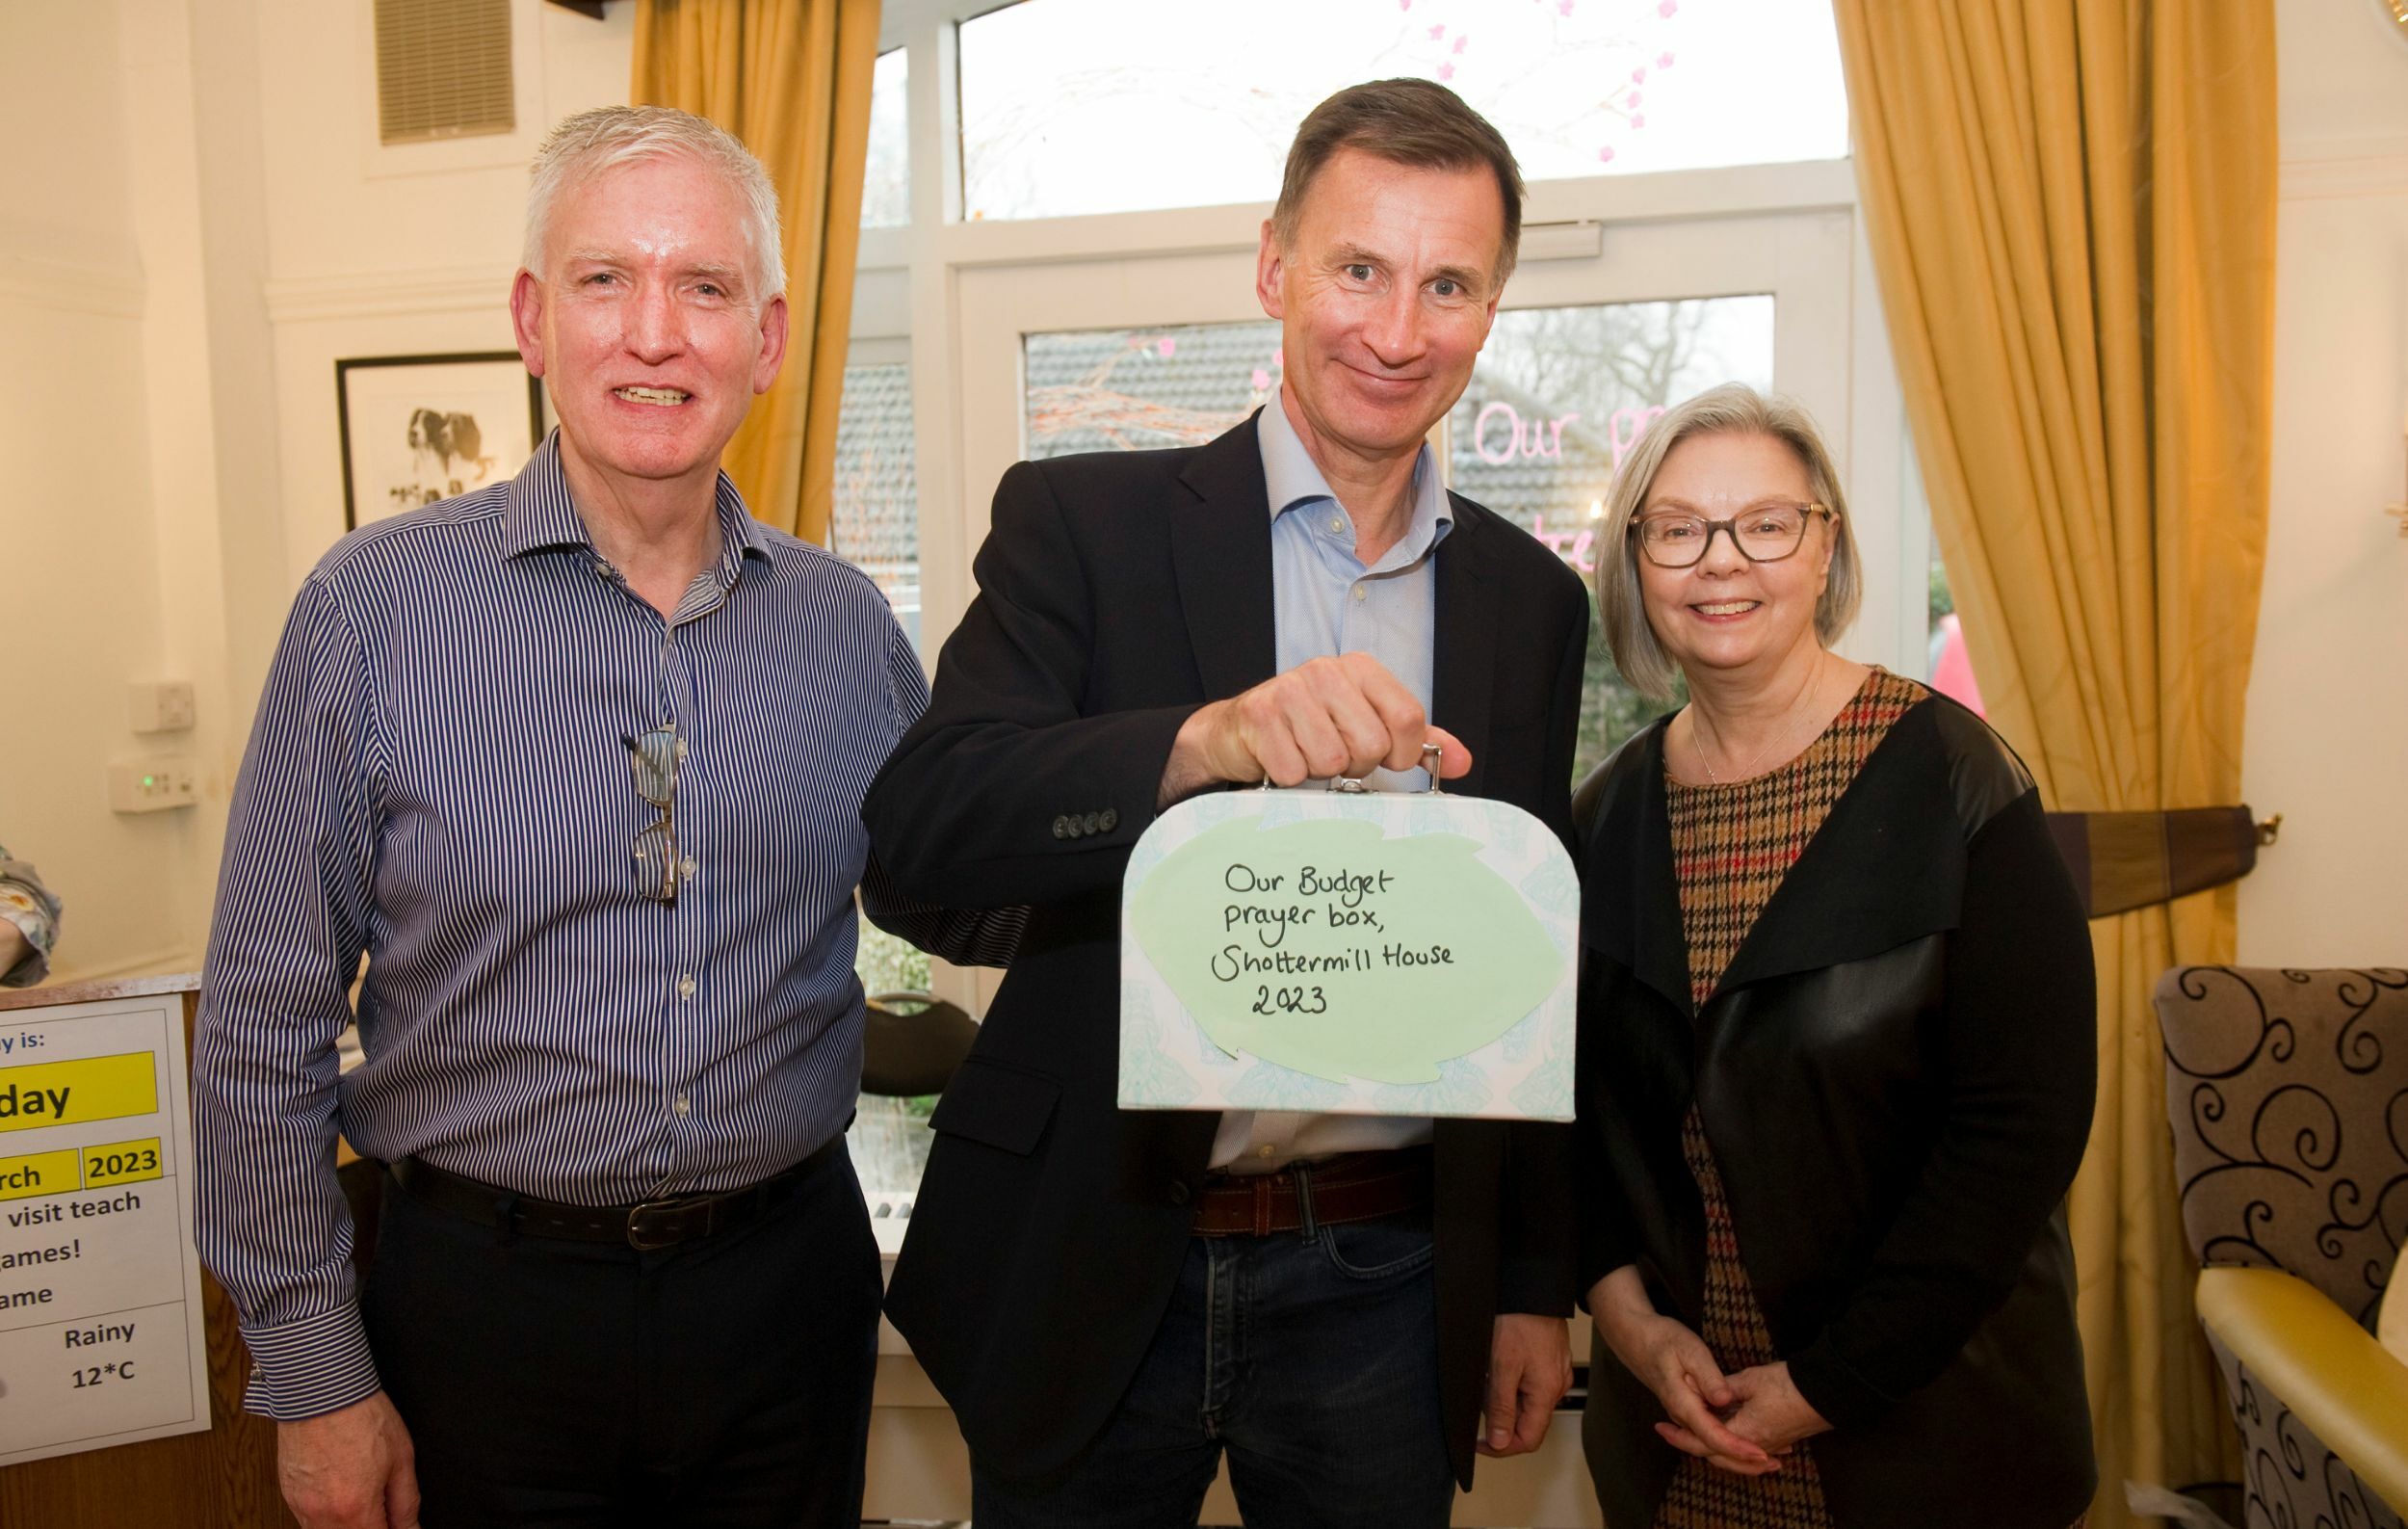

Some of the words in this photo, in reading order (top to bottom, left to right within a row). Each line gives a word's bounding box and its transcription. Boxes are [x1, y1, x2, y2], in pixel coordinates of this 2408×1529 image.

[1476, 402, 1579, 463] Our
[1225, 863, 1284, 892] Our
[1298, 865, 1395, 908] Budget
[1224, 905, 1316, 948] prayer
[1328, 903, 1384, 933] box,
[1212, 944, 1371, 982] Shottermill
[1382, 942, 1454, 967] House
[1252, 985, 1327, 1015] 2023
[0, 1038, 14, 1054] y
[20, 1032, 45, 1048] is:
[89, 1149, 157, 1178] 2023
[8, 1203, 64, 1227] visit
[69, 1191, 141, 1219] teach
[0, 1239, 81, 1273] ames!
[65, 1323, 136, 1349] Rainy
